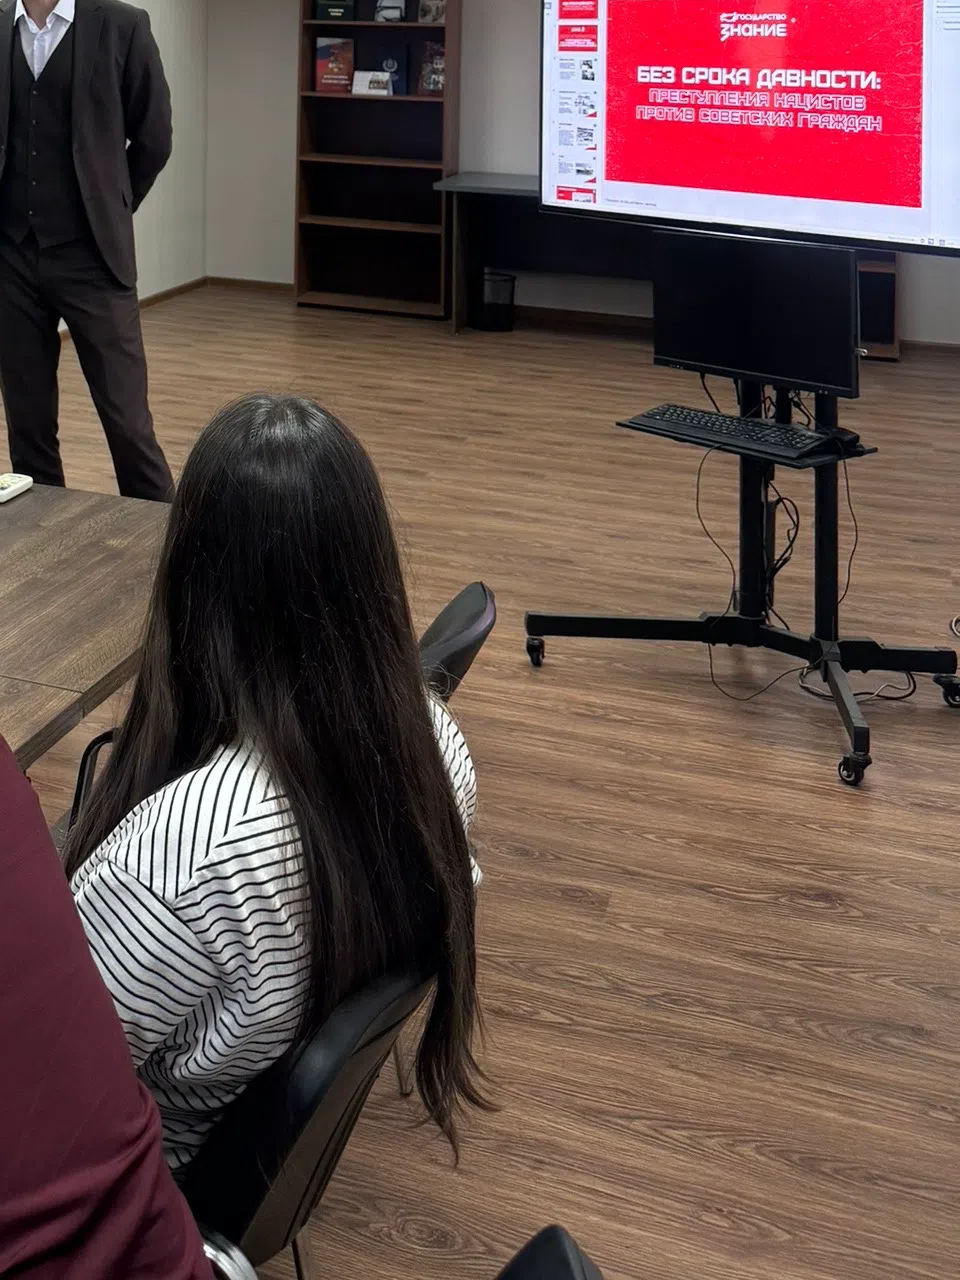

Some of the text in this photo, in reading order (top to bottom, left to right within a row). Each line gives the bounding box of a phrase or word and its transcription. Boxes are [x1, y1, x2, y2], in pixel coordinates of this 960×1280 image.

[637, 65, 881, 90] БЕЗ СРОКА ДАВНОСТИ:
[648, 87, 866, 111] ПРЕСТУПЛЕНИЯ НАЦИСТОВ
[635, 104, 882, 133] ПРОТИВ СОВЕТСКИХ ГРАЖДАН
